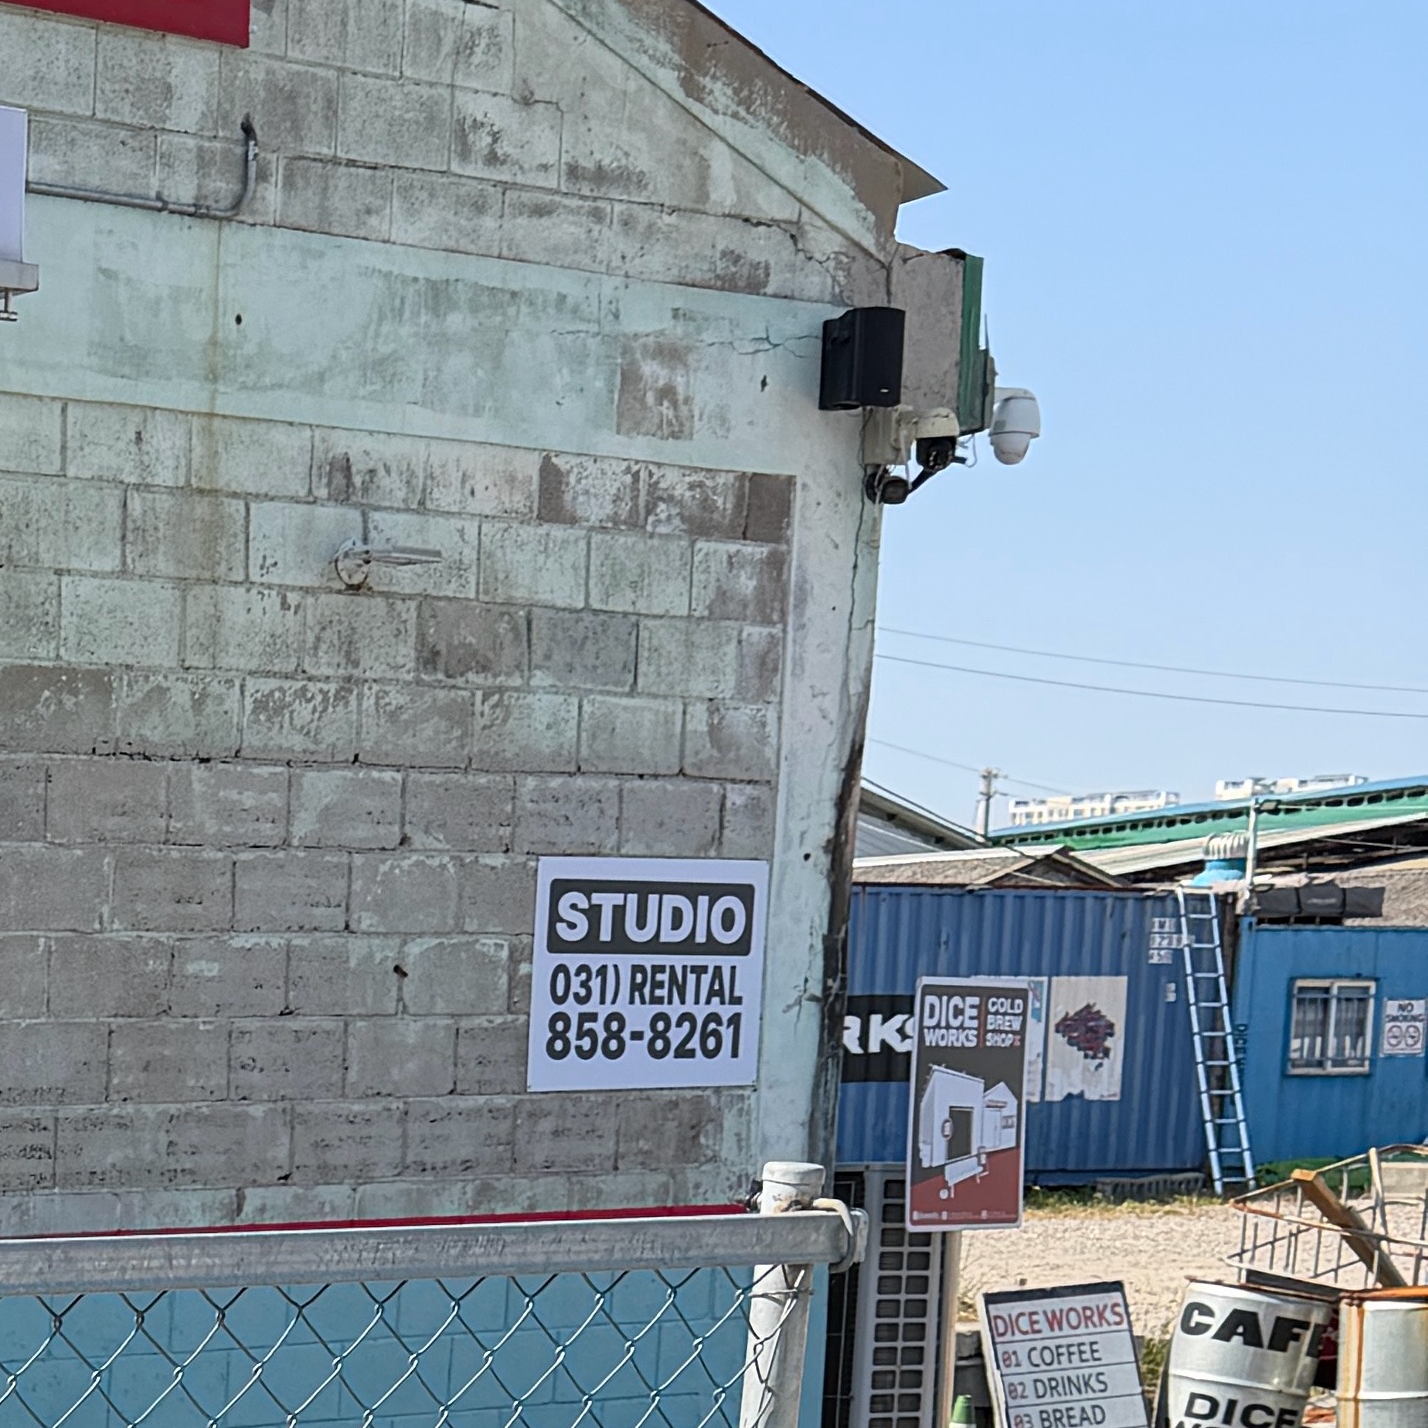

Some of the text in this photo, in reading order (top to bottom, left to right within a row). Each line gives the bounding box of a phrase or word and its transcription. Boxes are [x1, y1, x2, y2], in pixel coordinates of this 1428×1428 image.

[555, 891, 746, 944] STUDIO
[549, 963, 743, 1006] 031) RENTAL
[923, 995, 980, 1028] DICE
[988, 997, 1023, 1013] COLD
[1397, 1002, 1414, 1013] NO
[545, 1011, 741, 1060] 858-8261
[987, 1015, 1022, 1030] BREW
[924, 1028, 977, 1047] WORKS
[986, 1032, 1013, 1047] SHOP
[992, 1302, 1125, 1337] DICE WORKS
[1027, 1341, 1102, 1368] COFFEE
[1033, 1372, 1108, 1400] DRINKS
